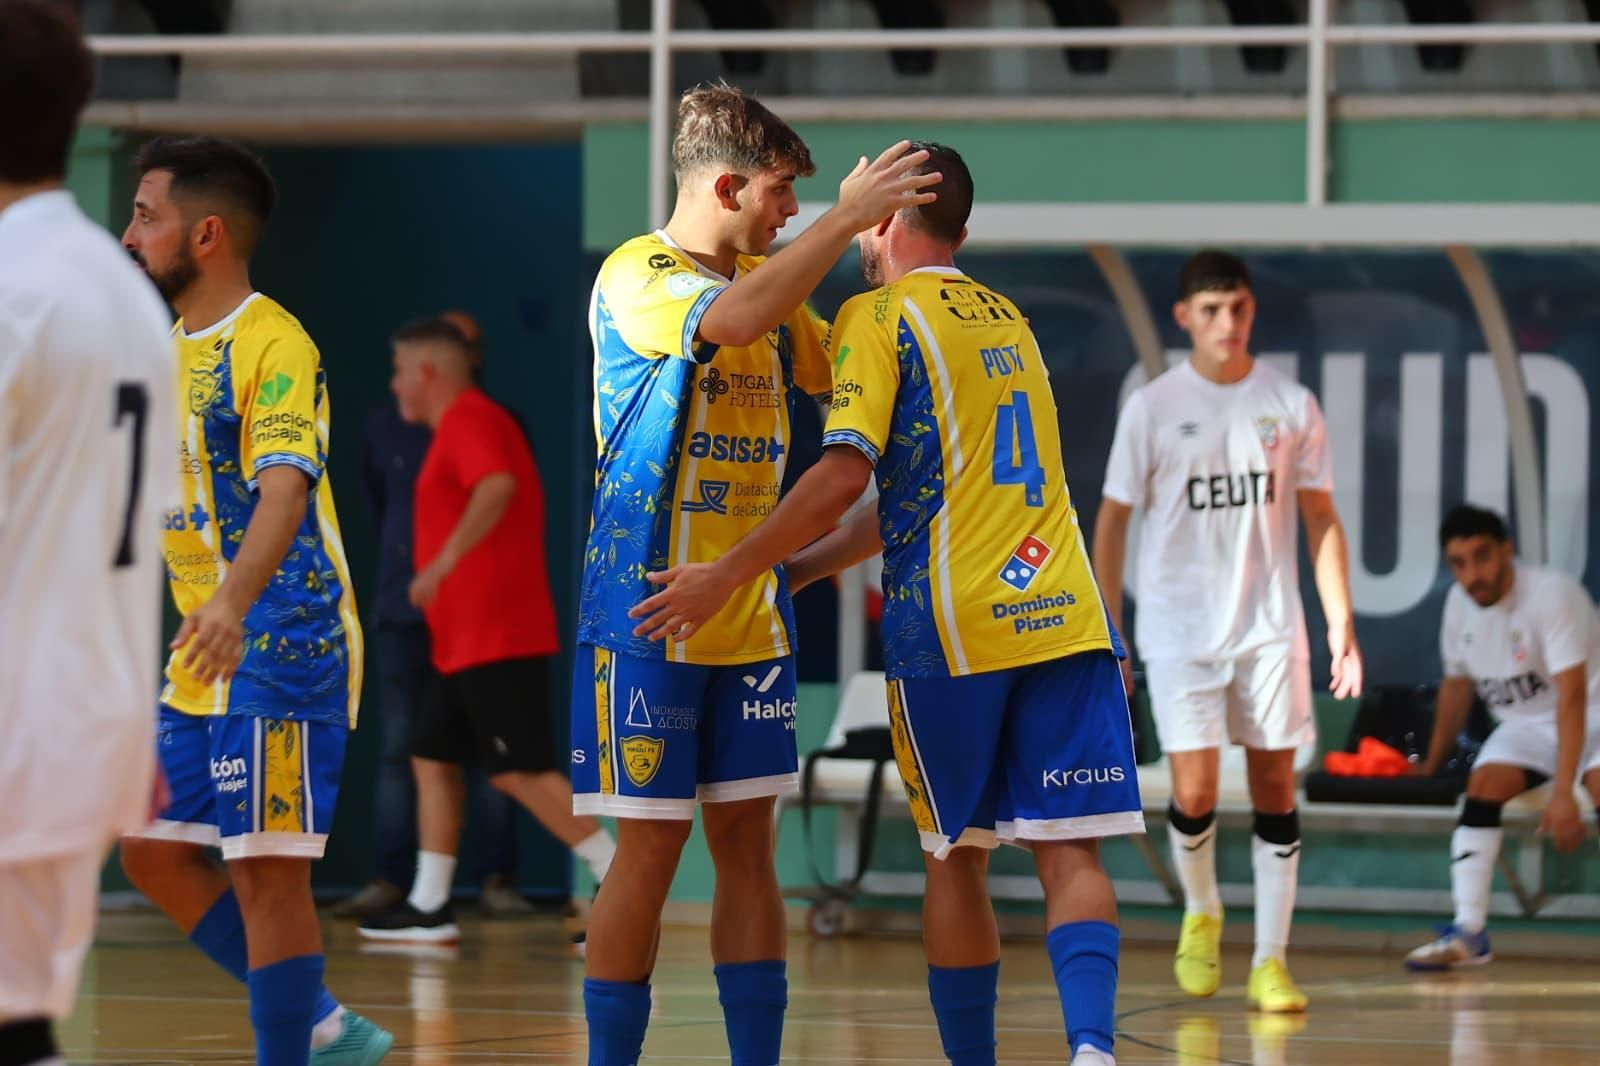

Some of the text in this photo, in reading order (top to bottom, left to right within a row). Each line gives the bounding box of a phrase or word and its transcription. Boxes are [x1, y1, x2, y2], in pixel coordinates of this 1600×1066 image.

[992, 391, 1046, 507] 4
[1187, 470, 1275, 510] CEUTA
[992, 590, 1076, 619] Domino's
[1014, 614, 1064, 634] Pizza
[743, 696, 797, 719] Halcó
[1043, 766, 1125, 788] Kraus
